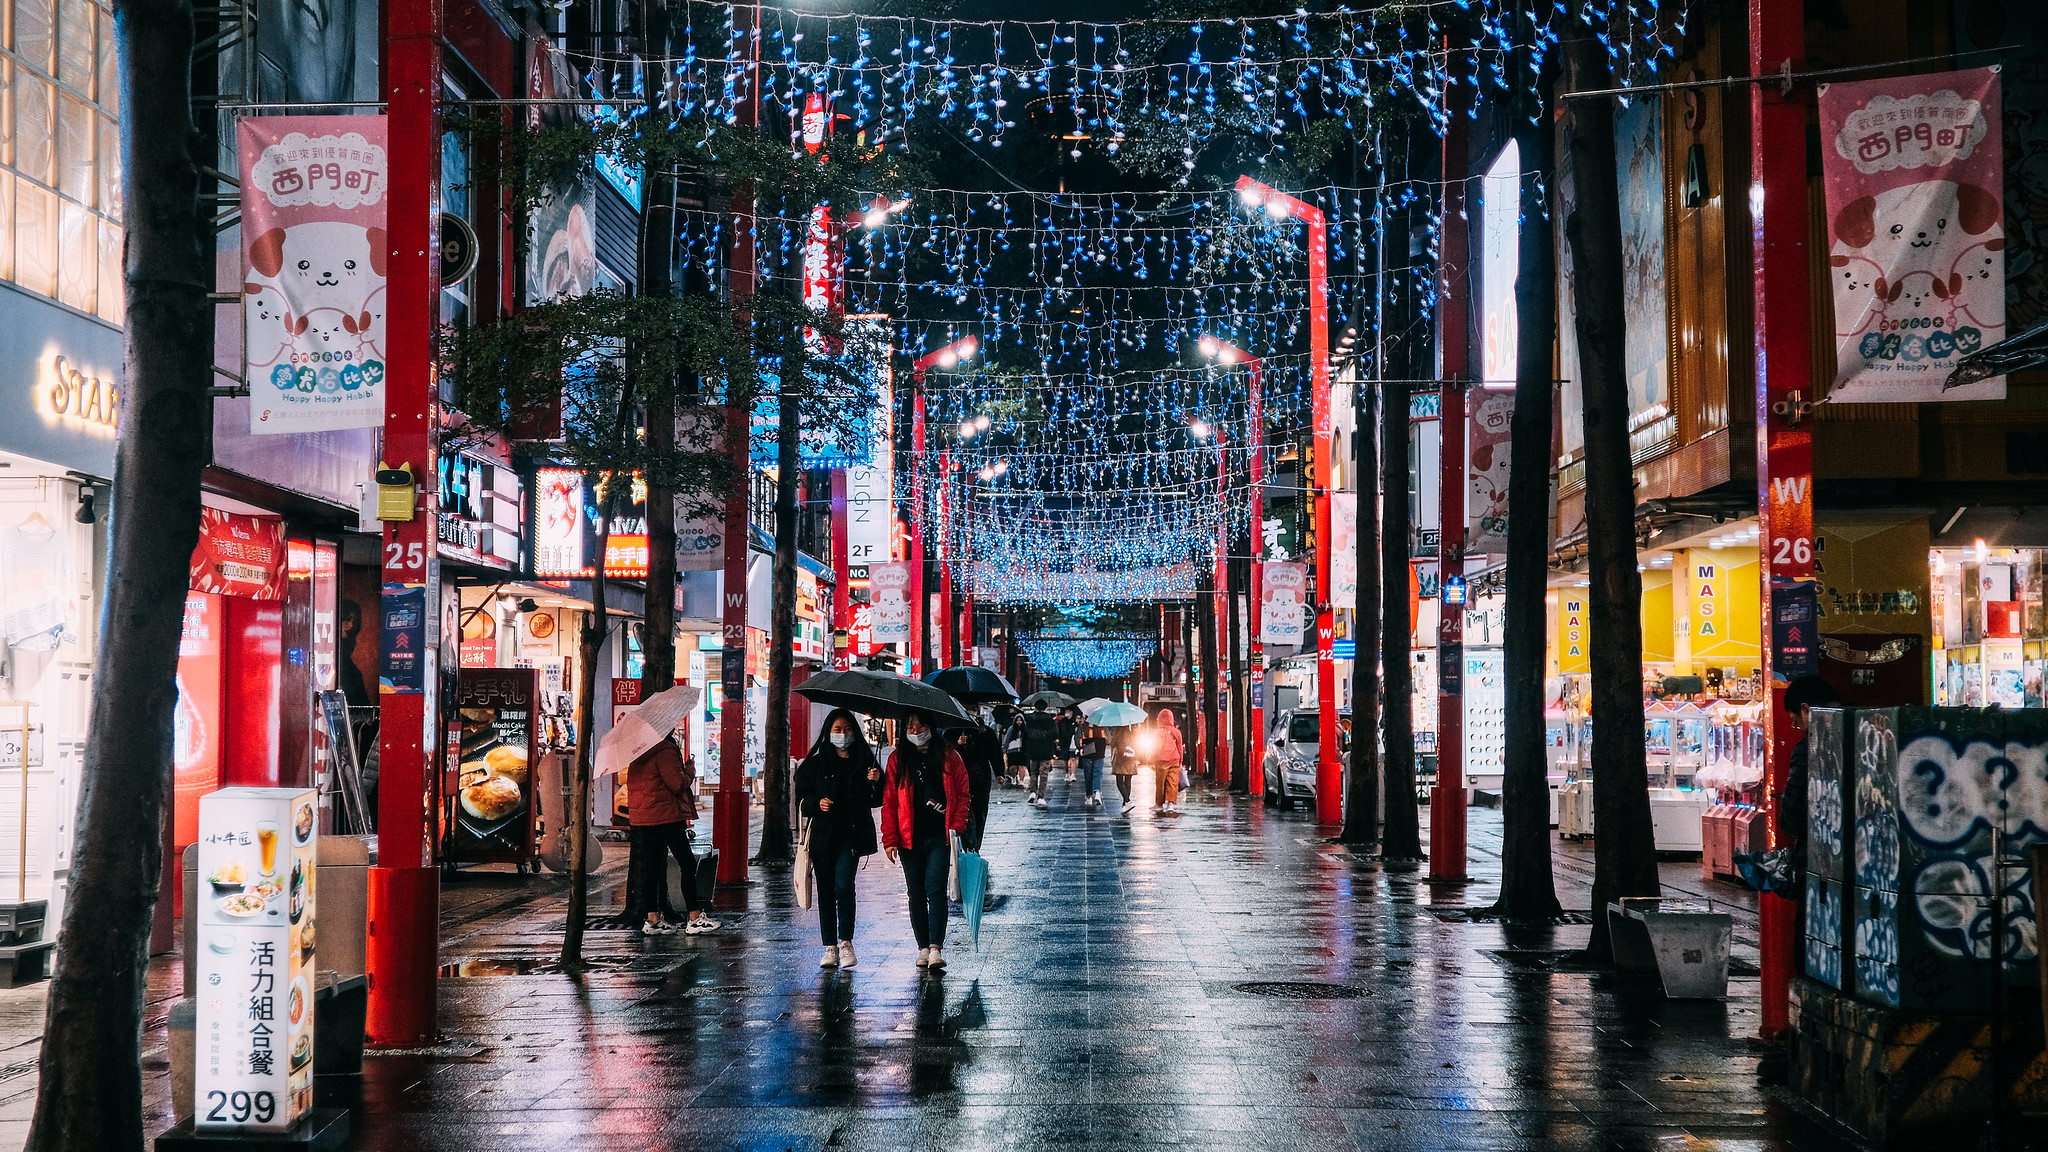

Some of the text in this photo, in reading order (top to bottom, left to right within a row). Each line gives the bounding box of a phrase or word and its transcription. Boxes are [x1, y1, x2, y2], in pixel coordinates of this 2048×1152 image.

[1858, 122, 1974, 162] 西門町
[273, 147, 375, 166] 歡迎來到優質商圈
[272, 162, 379, 196] 西門町
[1864, 362, 1892, 371] Happy
[1897, 363, 1928, 372] Happy
[283, 390, 374, 403] Happy Happy Habibi
[854, 470, 870, 523] SIGN
[1773, 477, 1807, 504] W
[439, 515, 478, 550] Buffalo
[386, 542, 424, 569] 25
[852, 545, 873, 557] 2F
[1772, 537, 1812, 564] 26
[849, 568, 869, 578] NO.
[726, 593, 743, 608] W
[1697, 564, 1716, 636] MASA
[725, 625, 743, 639] 23
[1442, 619, 1461, 633] 24
[1567, 601, 1581, 656] MASA
[1320, 629, 1332, 639] W
[834, 657, 848, 667] 21
[1319, 650, 1334, 660] 22
[910, 672, 920, 680] 19
[1252, 671, 1263, 679] 20
[616, 681, 636, 703] 伴
[205, 831, 252, 846] 小牛匠
[209, 974, 221, 984] 2F
[248, 940, 276, 1076] 活力組合餐
[206, 1089, 276, 1123] 299
